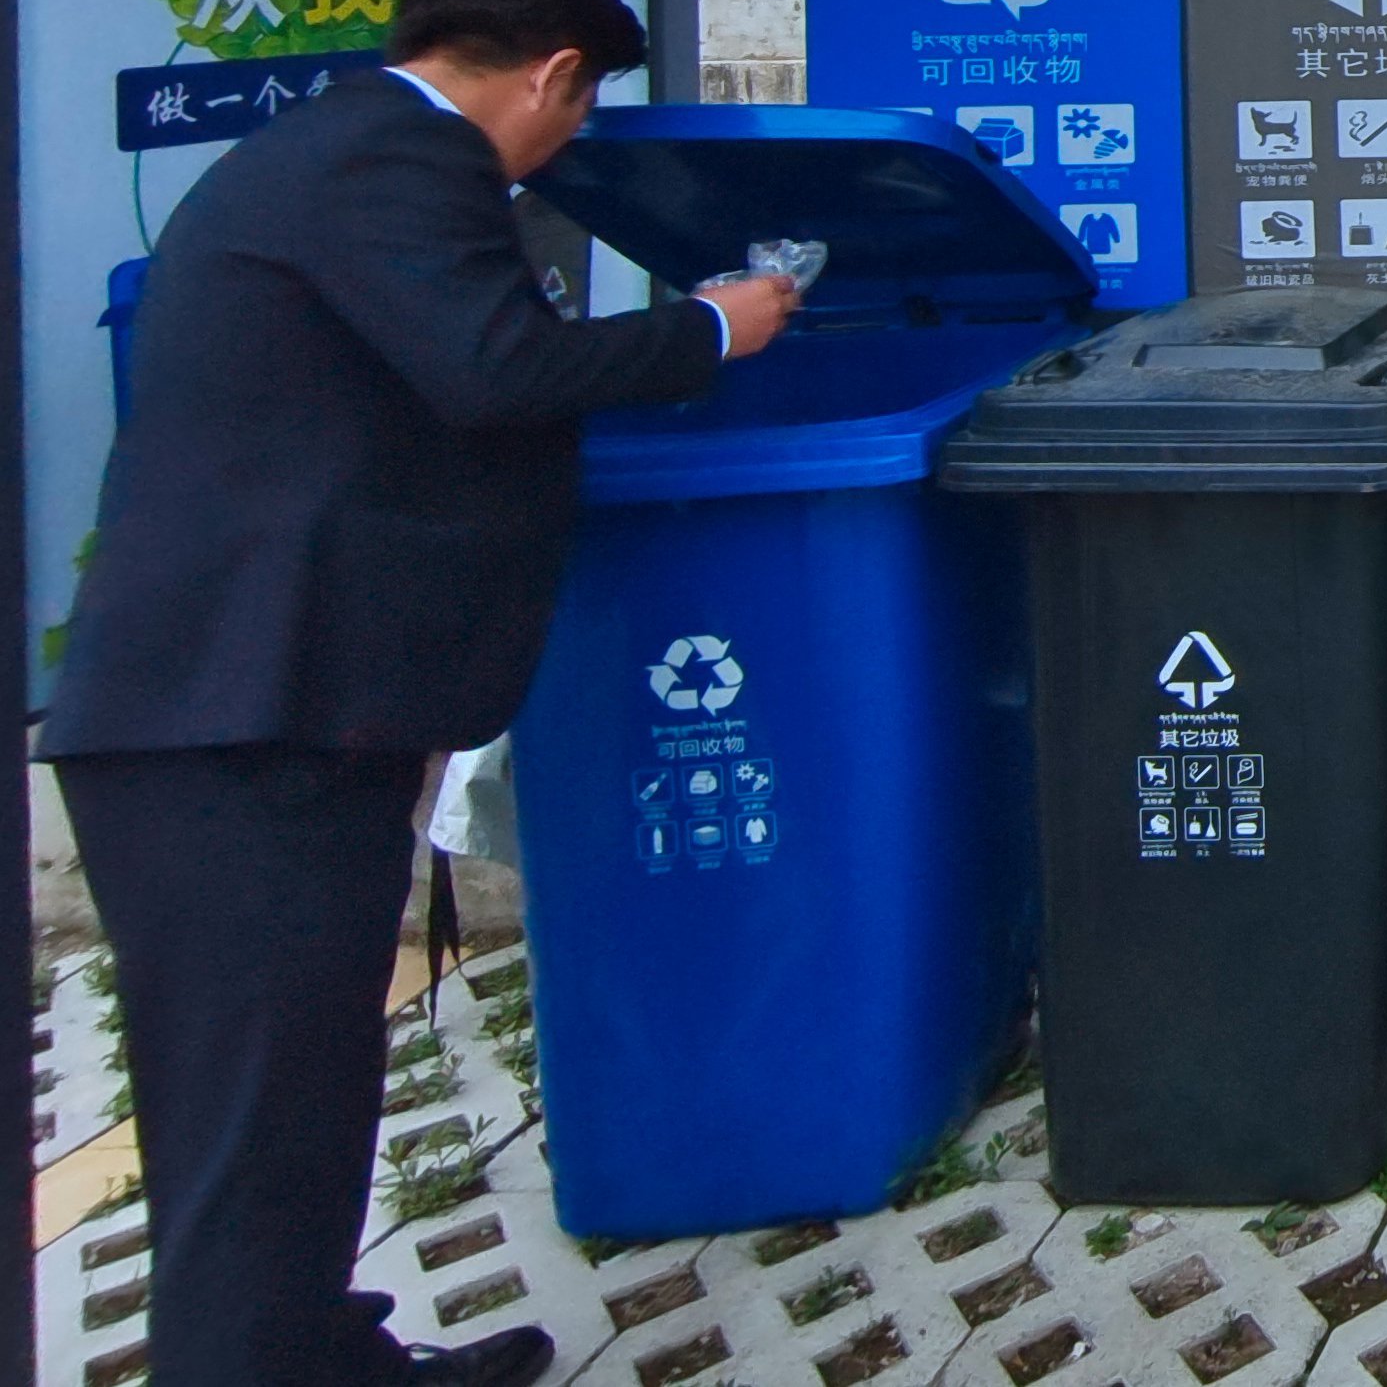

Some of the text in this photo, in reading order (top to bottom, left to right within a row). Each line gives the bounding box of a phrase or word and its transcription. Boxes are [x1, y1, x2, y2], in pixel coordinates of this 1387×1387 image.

[918, 54, 1082, 86] 可回收物
[657, 736, 745, 759] 可回收物
[1160, 728, 1240, 749] 其它垃圾
